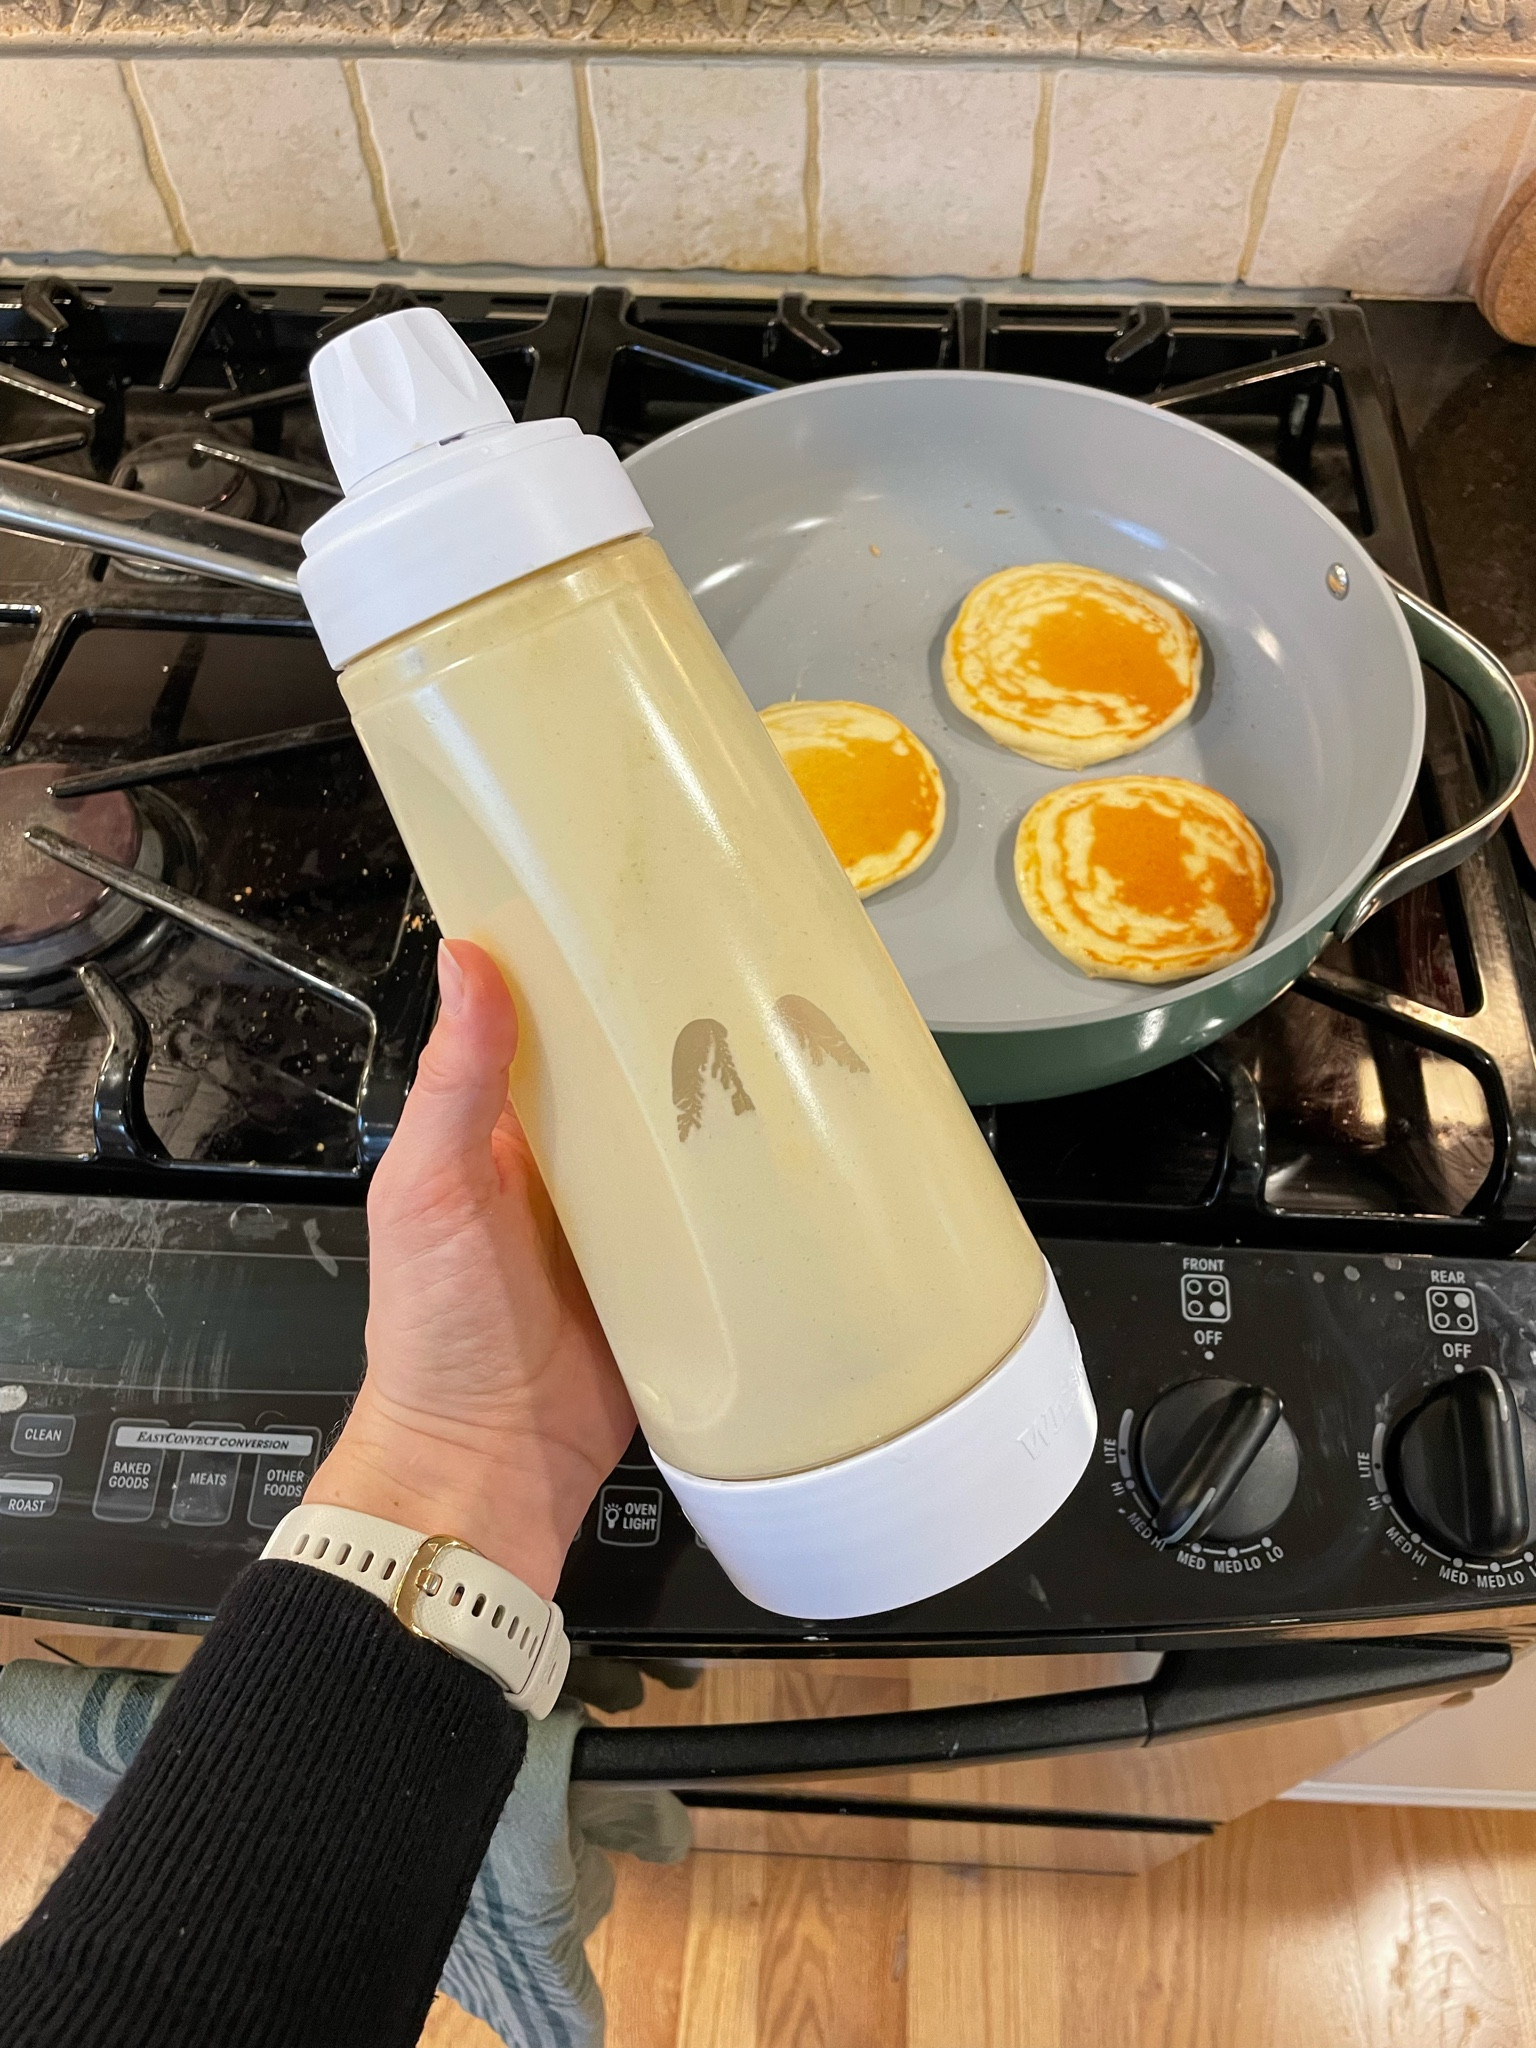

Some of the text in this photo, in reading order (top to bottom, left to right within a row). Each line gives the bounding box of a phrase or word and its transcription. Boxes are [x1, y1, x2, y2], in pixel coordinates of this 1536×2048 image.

[1183, 1257, 1225, 1272] FRONT
[1430, 1269, 1466, 1284] REAR
[1193, 1330, 1223, 1346] OFF
[1442, 1342, 1472, 1358] OFF
[24, 1428, 62, 1441] CLEAN
[219, 1437, 289, 1450] CONVERSION
[1103, 1438, 1117, 1464] LITE
[113, 1461, 151, 1475] BAKED
[1357, 1451, 1372, 1478] LITE
[108, 1475, 150, 1489] GOODS
[189, 1473, 227, 1487] MEATS
[266, 1469, 305, 1483] OTHER
[263, 1483, 302, 1497] FOODS
[1111, 1481, 1126, 1496] HI
[8, 1498, 46, 1512] ROAST
[624, 1502, 657, 1516] OVEN
[1366, 1495, 1383, 1511] HI
[622, 1517, 657, 1531] LIGHT
[1127, 1512, 1167, 1552] MED HI
[1266, 1545, 1285, 1563] LO
[1385, 1526, 1428, 1567] MED HI
[1176, 1550, 1206, 1570] MED
[1213, 1556, 1262, 1573] MED LO
[1438, 1564, 1469, 1585] MED
[1476, 1570, 1525, 1588] MED LO
